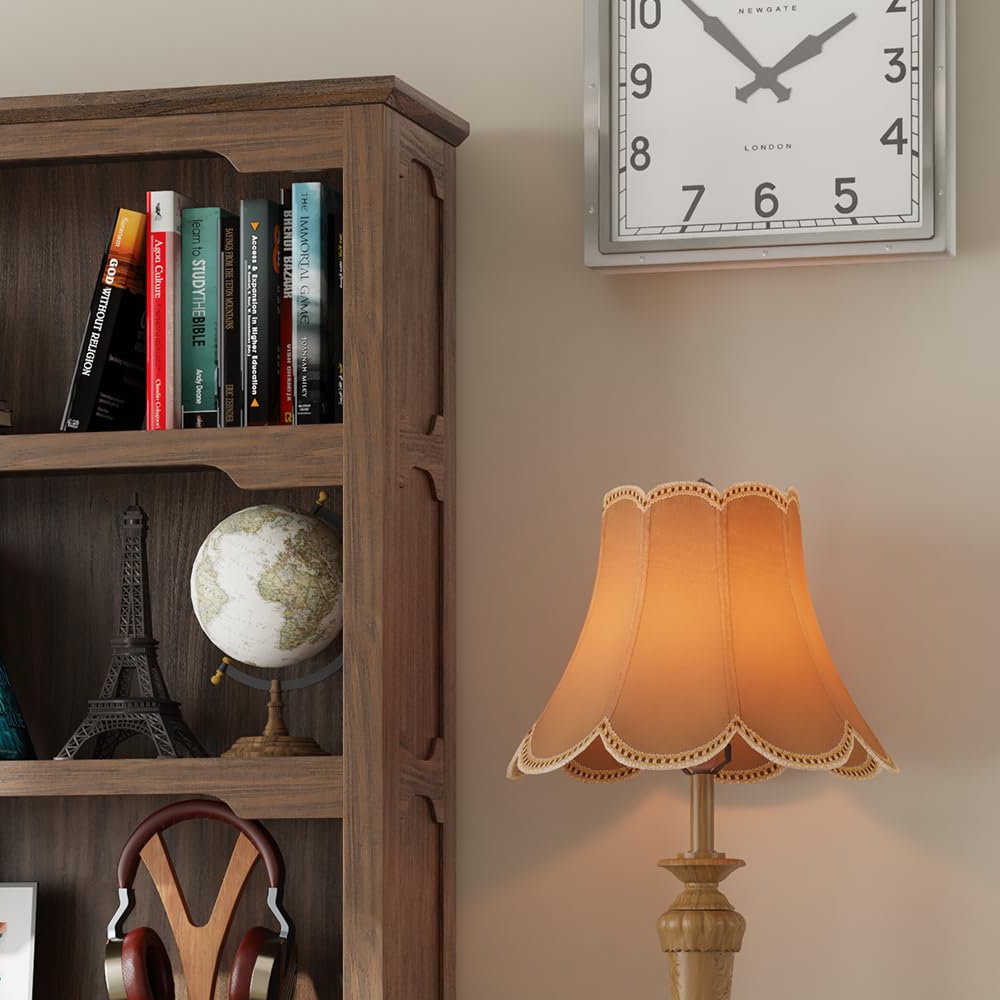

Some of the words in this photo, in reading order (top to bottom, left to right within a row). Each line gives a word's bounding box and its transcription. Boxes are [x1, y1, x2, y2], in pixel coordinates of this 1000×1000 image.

[630, 0, 661, 29] 10
[738, 5, 798, 14] NEWGATE
[884, 48, 906, 83] 3
[630, 63, 652, 99] 9
[744, 143, 793, 152] LONDON
[880, 118, 908, 155] 4
[630, 136, 651, 171] 8
[301, 192, 309, 212] THE
[682, 184, 706, 222] 7
[754, 182, 779, 218] 6
[834, 177, 858, 214] 5
[192, 219, 203, 244] learn
[225, 227, 234, 250] SAYINGS
[283, 210, 292, 251] BHENDI
[153, 239, 163, 263] Agon
[192, 246, 202, 256] to
[225, 251, 234, 266] FROM
[298, 216, 310, 280] IMMORTAL
[105, 258, 119, 284] GOD
[154, 265, 164, 298] Culture
[225, 267, 234, 278] THE
[283, 256, 292, 299] BAZAAR
[225, 279, 234, 296] TETON
[250, 274, 259, 314] Expansion
[92, 287, 112, 332] WITHOUT
[225, 297, 234, 329] MOUNTAINS
[299, 285, 310, 325] GAME
[251, 316, 258, 324] in
[250, 326, 259, 353] Higher
[81, 332, 100, 377] RELIGION
[154, 378, 162, 401] Claudio
[194, 369, 204, 385] Andy
[225, 384, 234, 398] ERIC
[195, 386, 203, 404] Deane
